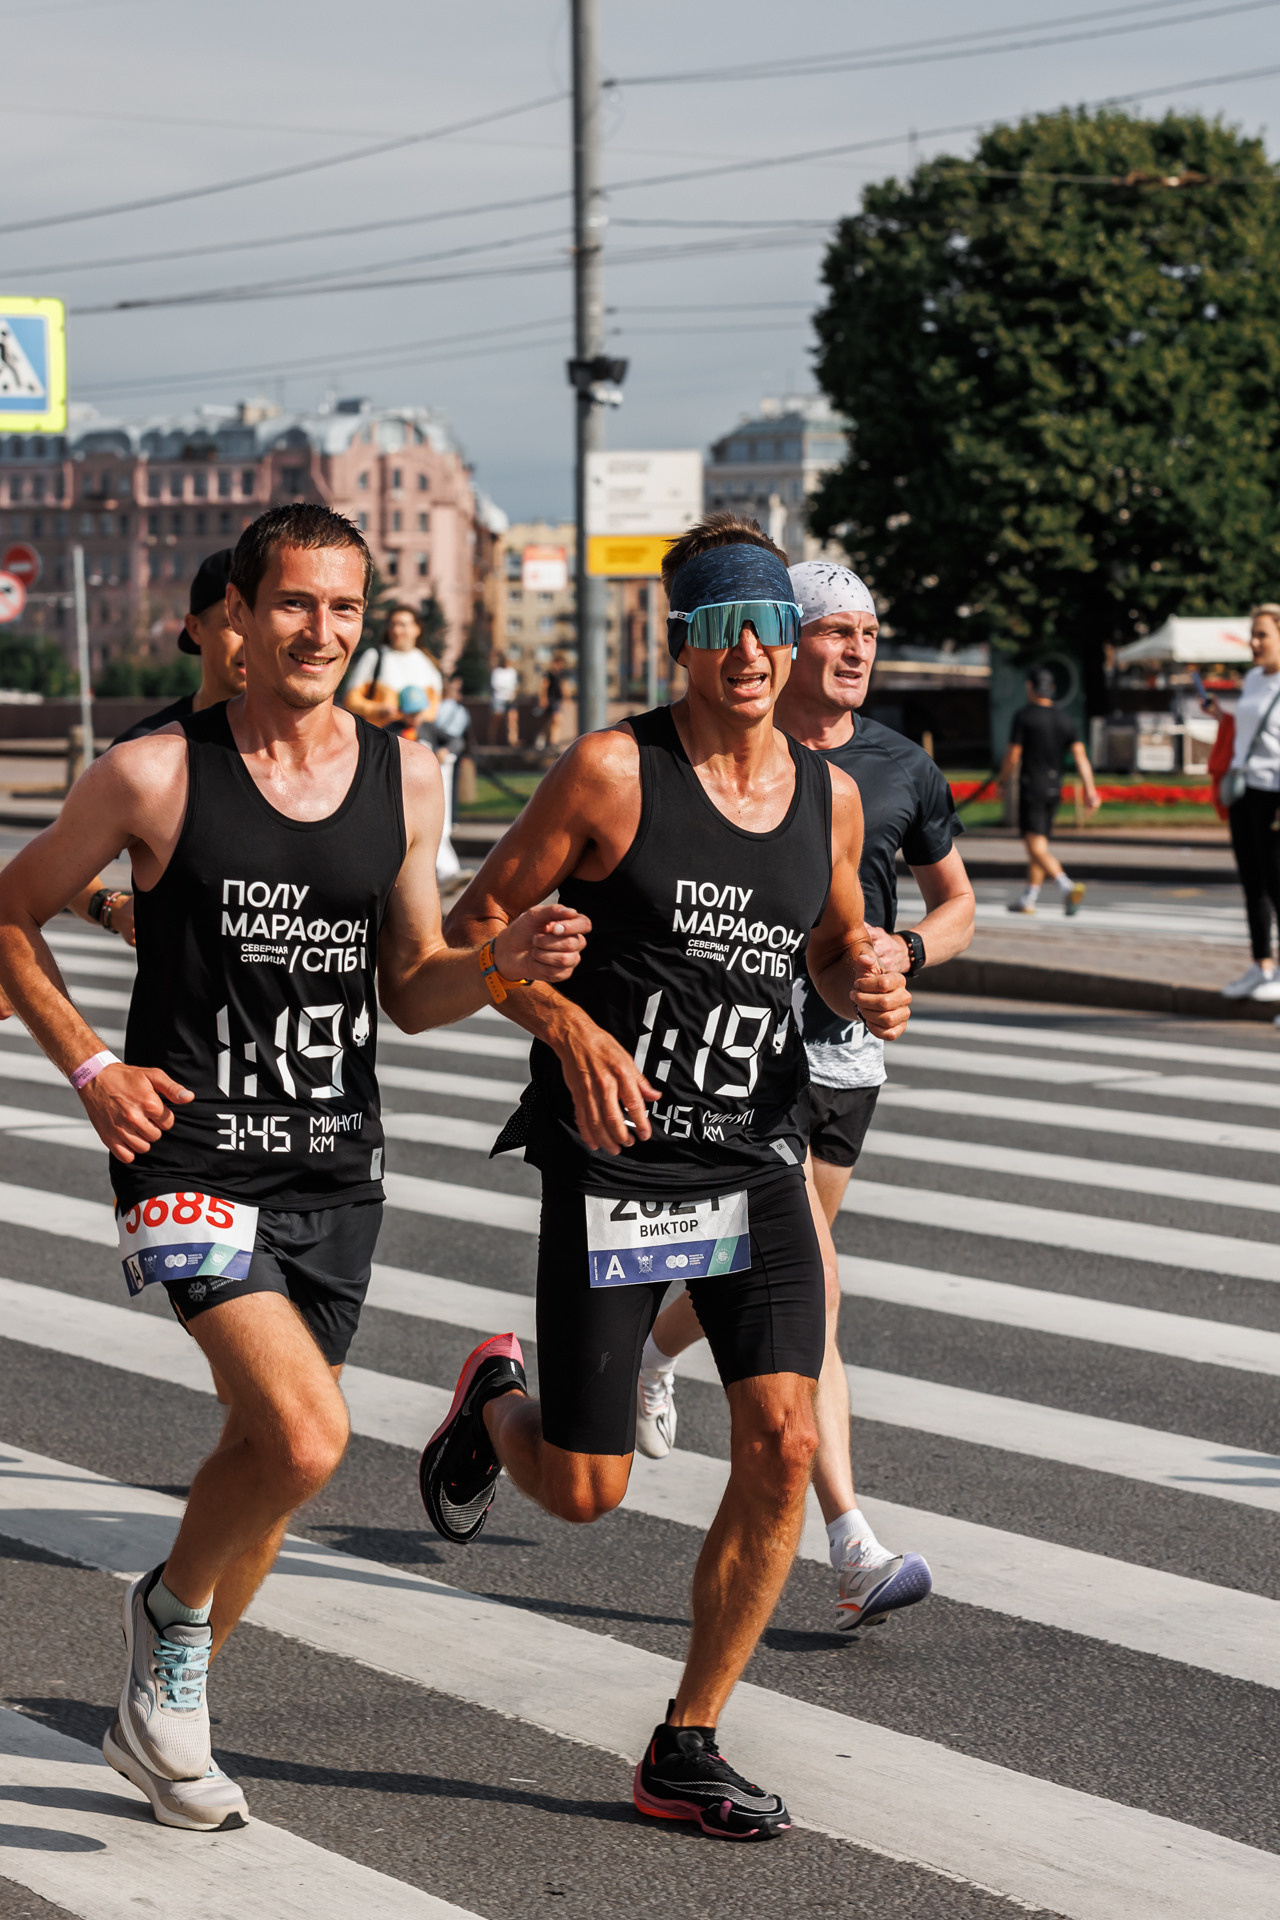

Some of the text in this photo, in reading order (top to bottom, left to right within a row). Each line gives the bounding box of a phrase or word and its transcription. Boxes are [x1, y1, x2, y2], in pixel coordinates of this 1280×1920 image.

[222, 879, 310, 909] ПОЛУ
[675, 879, 754, 912] ПОЛУ
[221, 910, 369, 943] МАРАФОН
[672, 909, 805, 954] МАРАФОН
[241, 943, 289, 955] СЕВЕРНАЯ
[685, 948, 726, 963] СТОЛИЦА
[687, 938, 730, 953] СЕВЕРНАЯ
[240, 953, 287, 966] СТОЛИЦА
[216, 1003, 345, 1100] 1:19
[633, 989, 772, 1098] 1:19
[216, 1113, 292, 1152] 3:45
[309, 1135, 335, 1153] КМ
[702, 1125, 725, 1142] КМ
[639, 1219, 700, 1238] ВИКТОР
